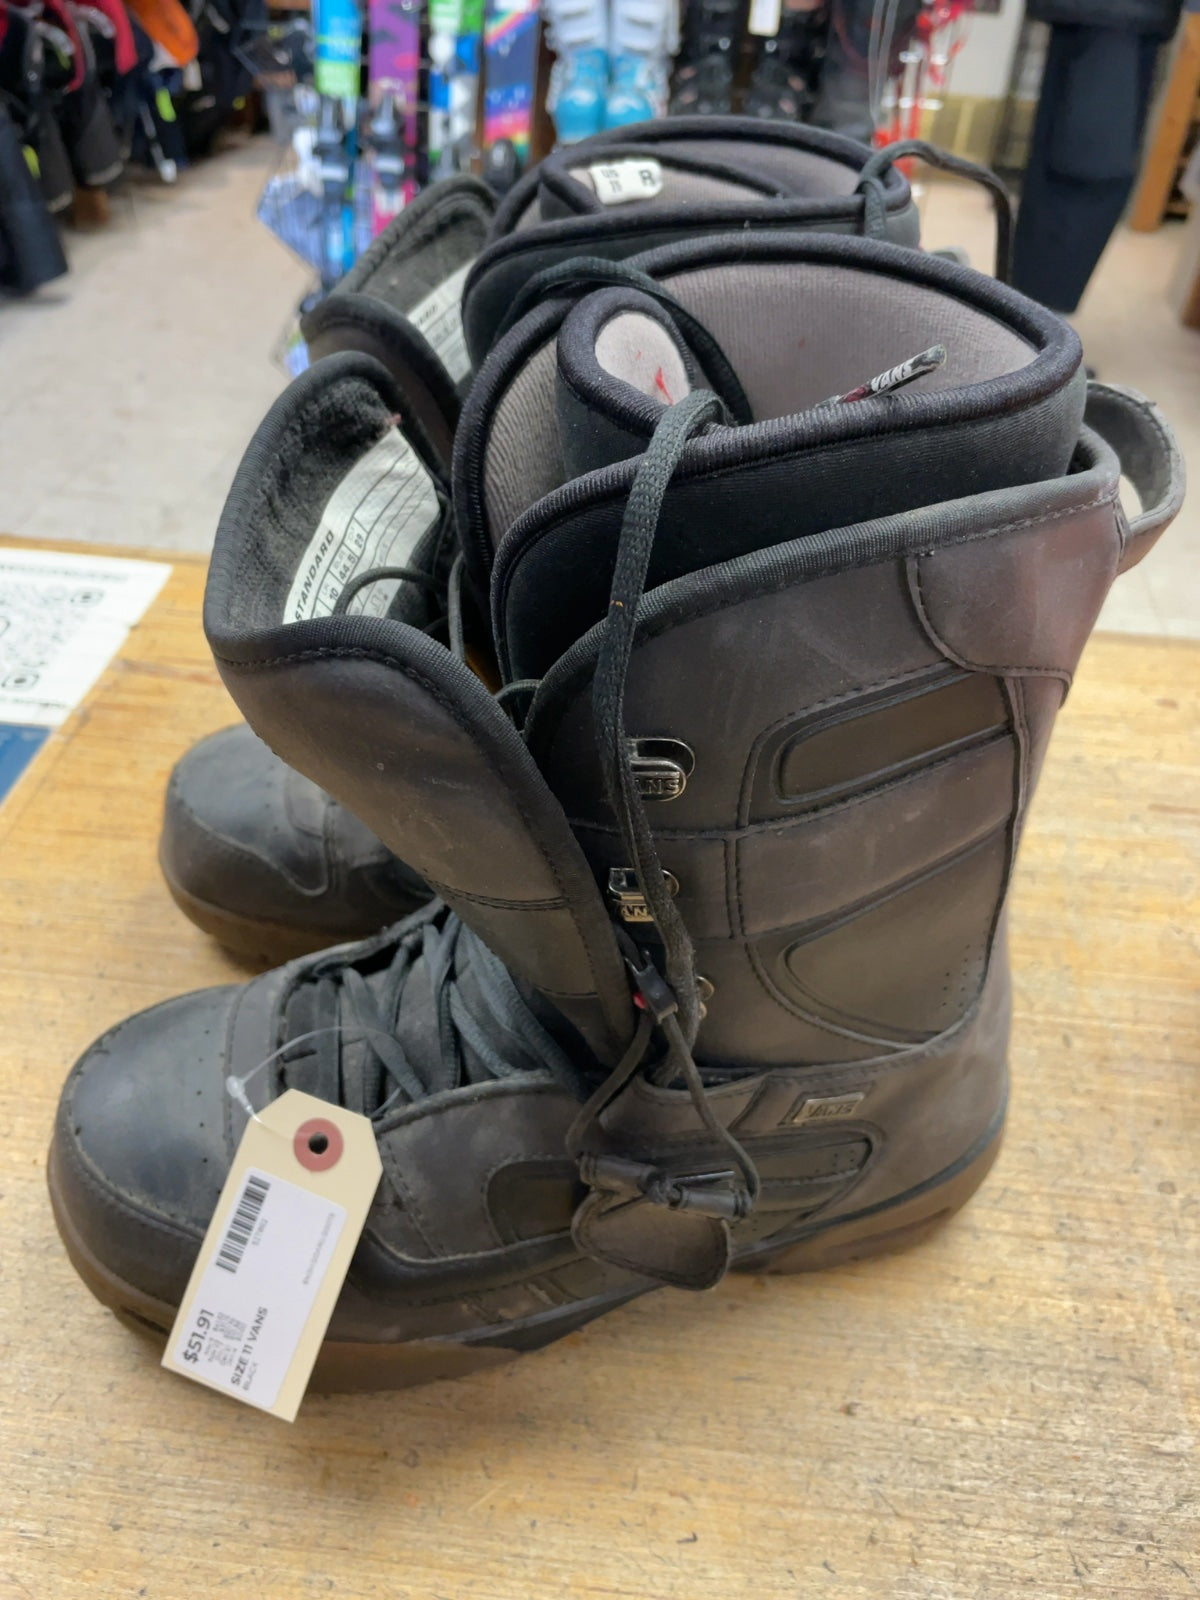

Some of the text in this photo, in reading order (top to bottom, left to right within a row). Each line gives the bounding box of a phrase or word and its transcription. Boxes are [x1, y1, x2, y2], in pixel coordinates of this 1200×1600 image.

[639, 169, 656, 186] R
[295, 530, 335, 621] STANDARD
[338, 555, 357, 580] 44.5
[328, 587, 340, 602] 10
[807, 1103, 854, 1117] VANS
[183, 1309, 214, 1364] $51.91
[231, 1306, 268, 1386] SIZE 11 VANS
